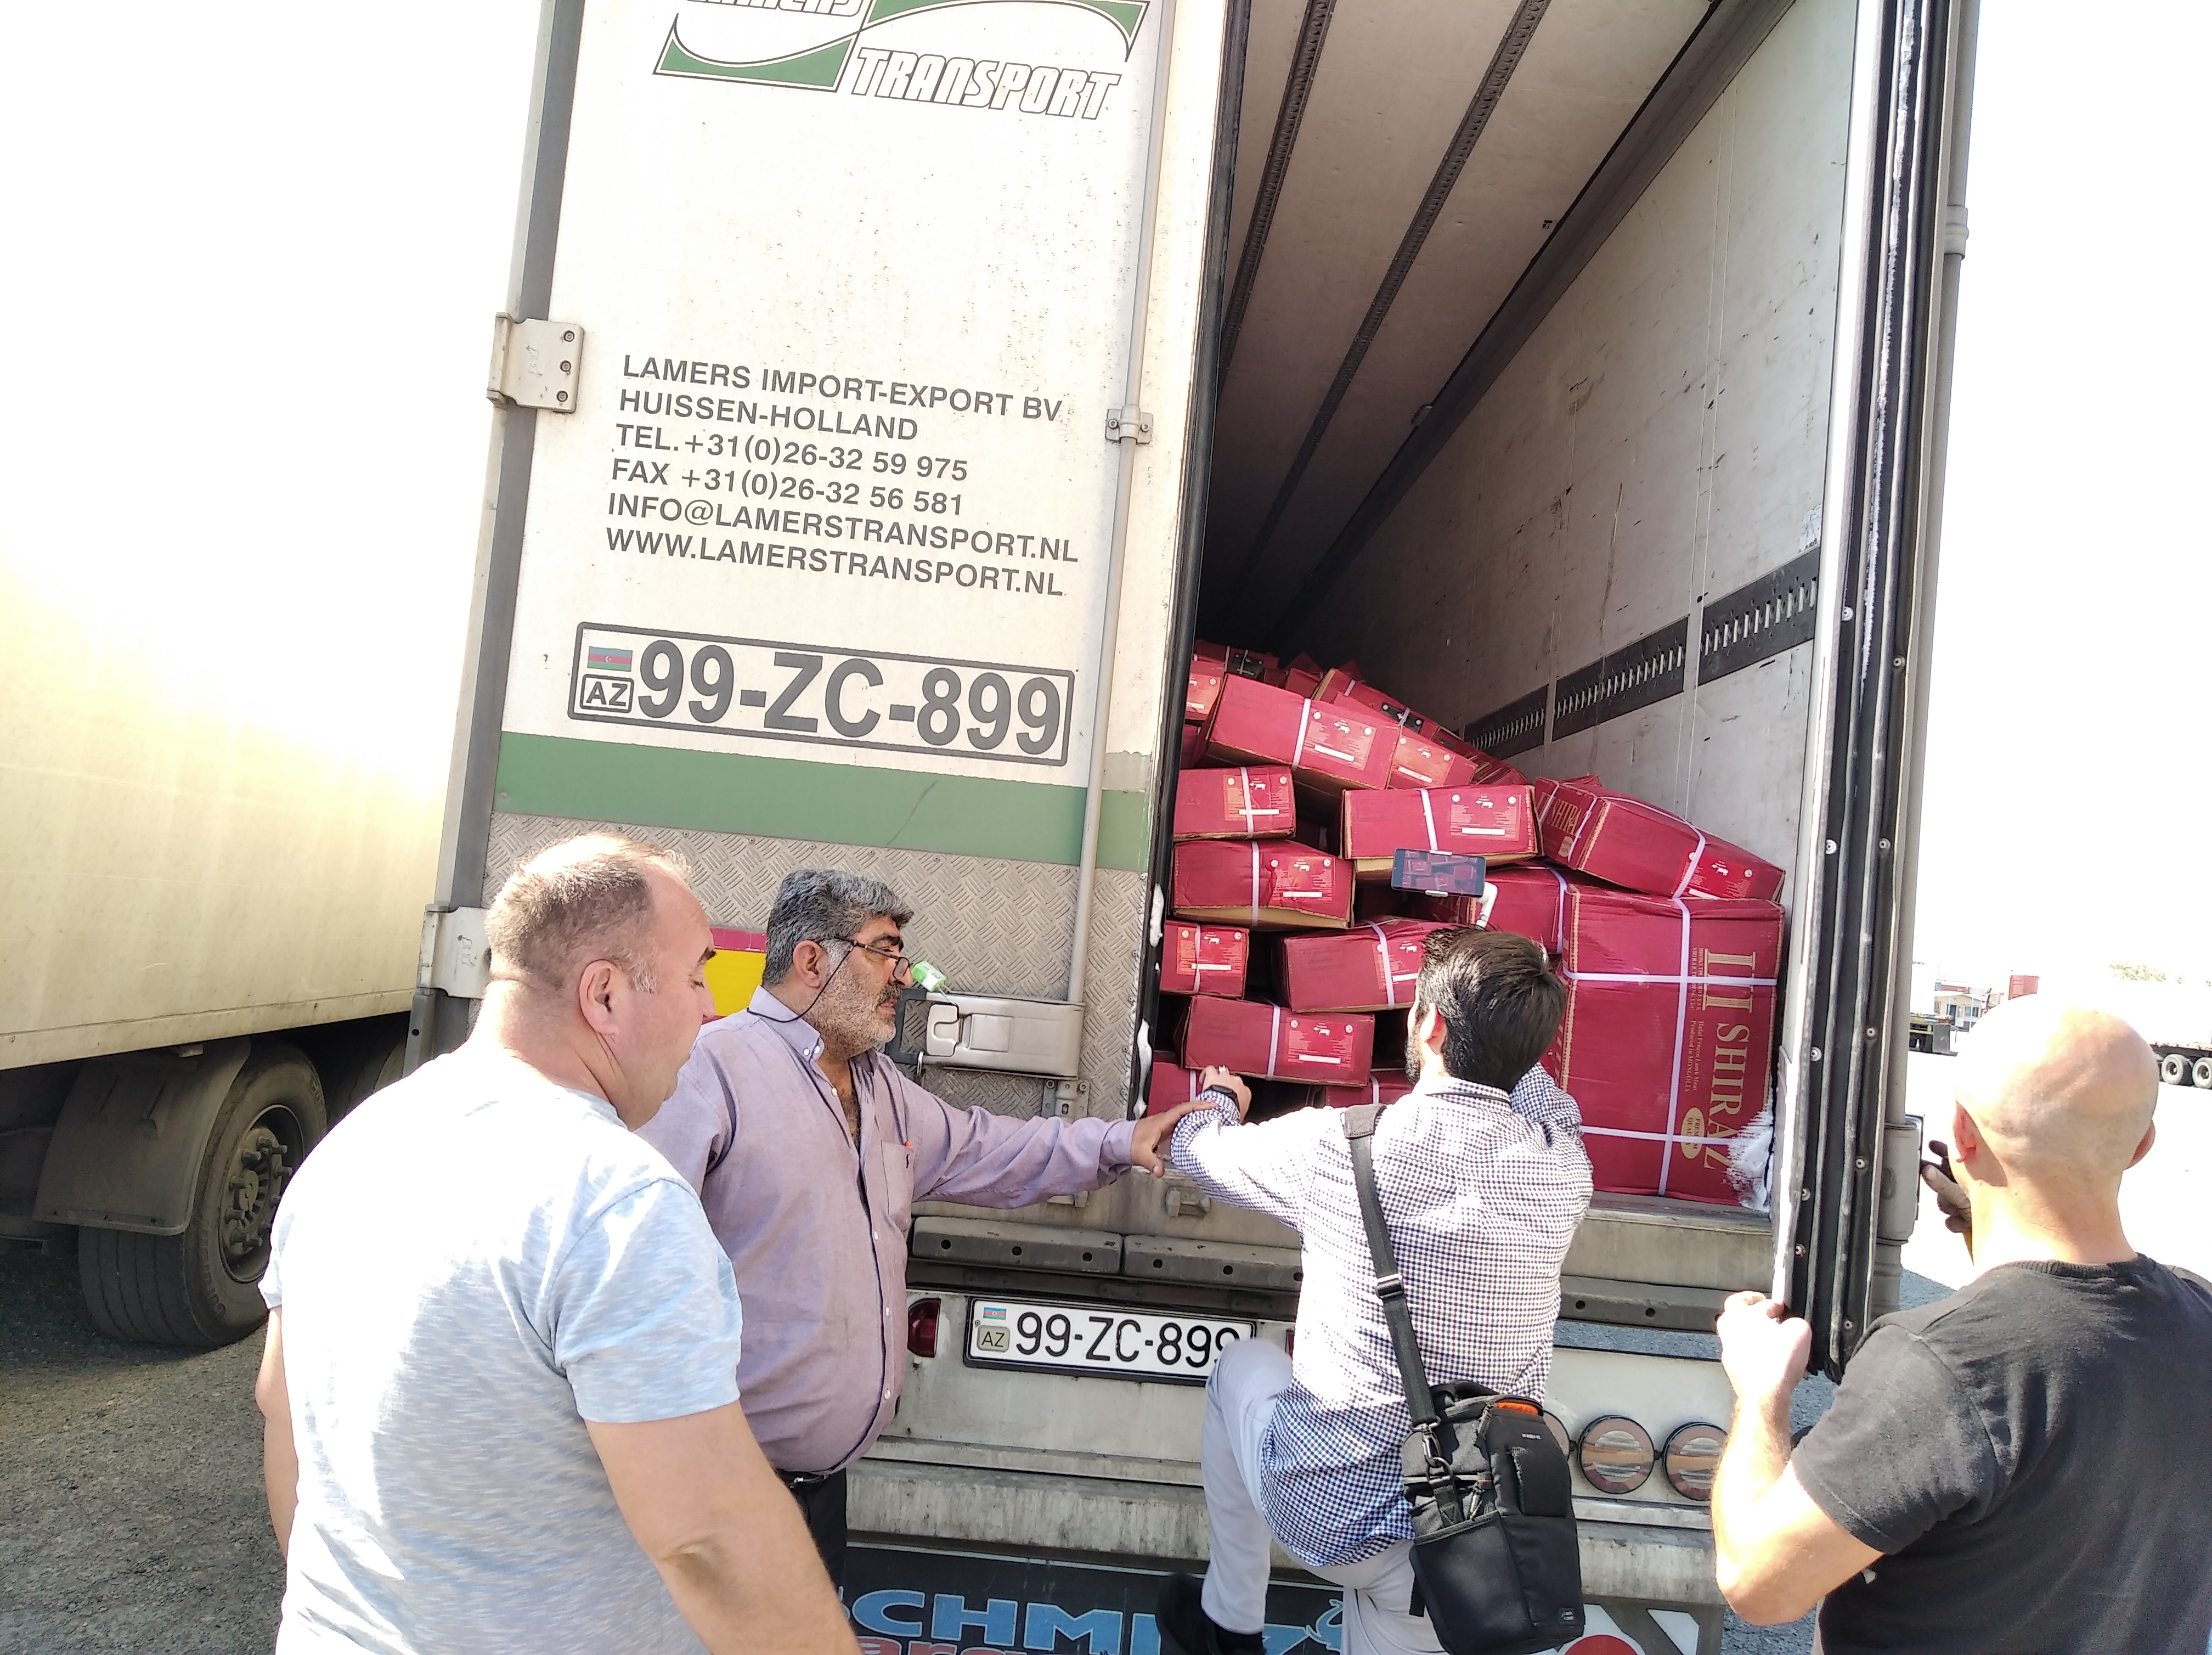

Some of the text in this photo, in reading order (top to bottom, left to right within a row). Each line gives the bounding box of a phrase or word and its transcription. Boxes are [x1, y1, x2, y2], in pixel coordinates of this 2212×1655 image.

[851, 47, 1122, 120] TRANSPORT
[619, 389, 918, 440] HUISSEN-HOLLAND
[623, 354, 1063, 421] LAMERS IMPORT-EXPORT BV
[612, 458, 961, 516] FAX +31(0)26-32 56 581
[872, 451, 906, 475] 59
[917, 455, 967, 481] 975
[608, 492, 1078, 562] INFO@LAMERSTRANSPORT.NL
[606, 527, 1063, 596] WWW.LAMERSTRANSPORT.NL
[585, 680, 627, 707] AZ
[637, 639, 1061, 755] 99-ZC-899
[1689, 1020, 1697, 1047] Produced
[1685, 1056, 1694, 1091] MONGOLIA
[980, 1331, 1005, 1348] AZ
